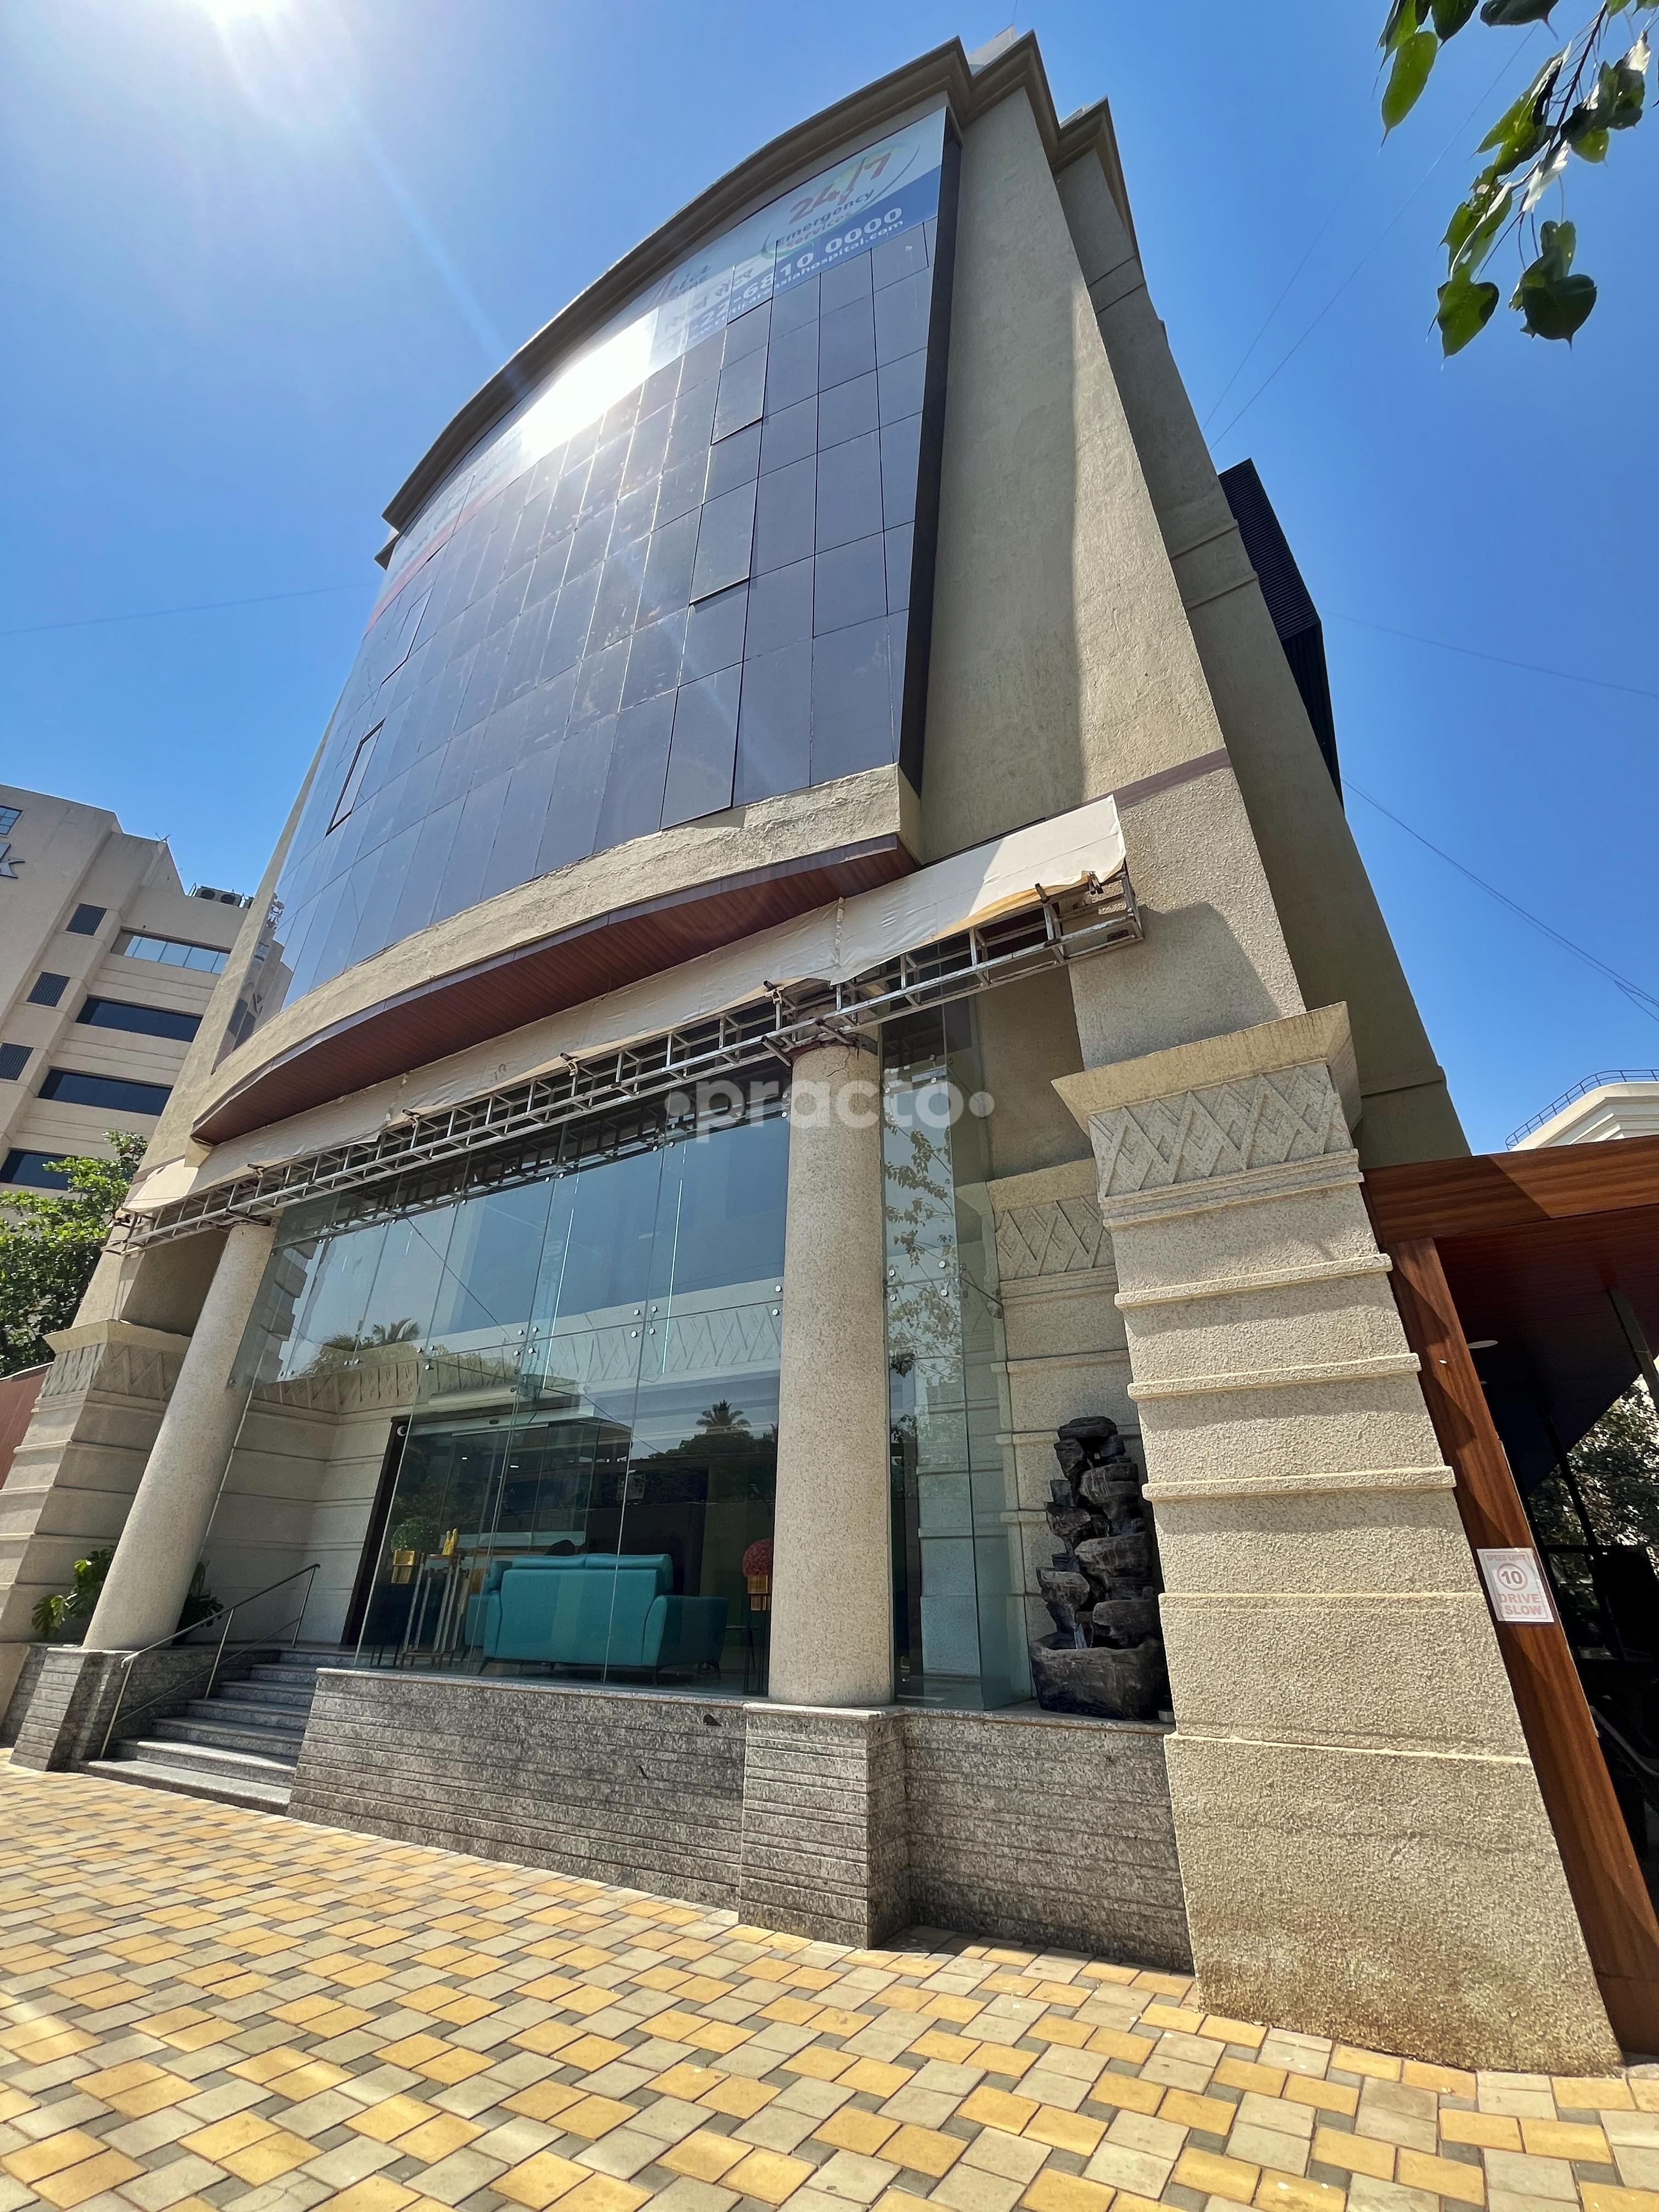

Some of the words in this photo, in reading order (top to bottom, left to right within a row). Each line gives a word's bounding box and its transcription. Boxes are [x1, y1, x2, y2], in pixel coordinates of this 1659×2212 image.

[789, 153, 891, 225] 24/7
[777, 189, 874, 246] Emergency
[825, 207, 902, 253] 0000
[1501, 1571, 1522, 1584] 10
[1499, 1593, 1541, 1603] DRIVE
[1505, 1605, 1542, 1615] SLOW
